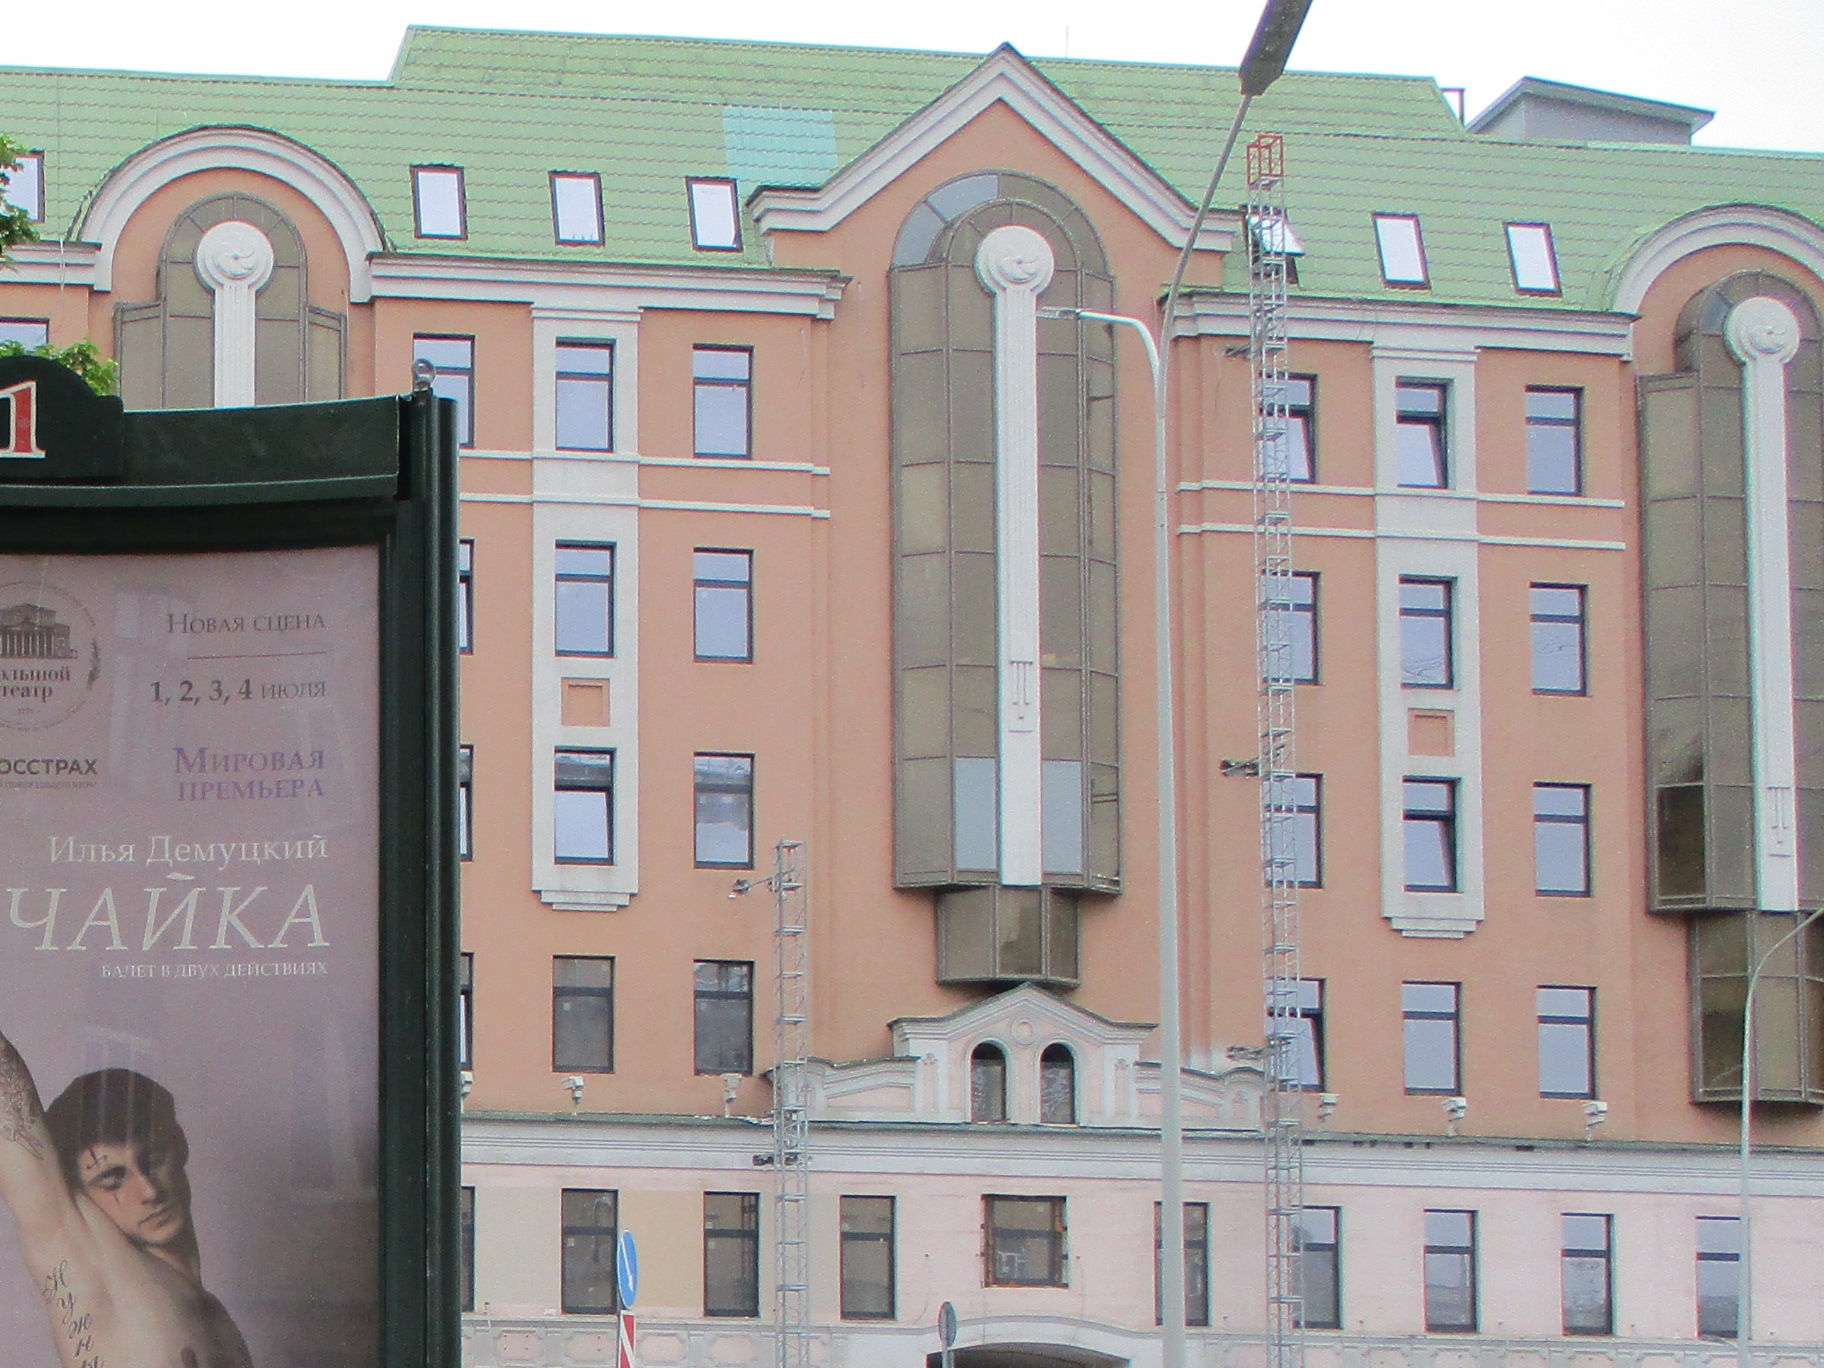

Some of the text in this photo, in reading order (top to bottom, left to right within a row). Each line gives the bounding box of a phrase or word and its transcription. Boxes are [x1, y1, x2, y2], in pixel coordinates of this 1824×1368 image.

[0, 685, 53, 703] театр
[238, 678, 253, 700] 4
[179, 779, 325, 801] ПРЕМЬЕРА
[48, 834, 329, 871] Илья Демуцкий
[5, 871, 331, 951] ЧАЙКА
[101, 961, 329, 979] БАЛЕТ В ДВУХ ДЕЙСТВИЯХ
